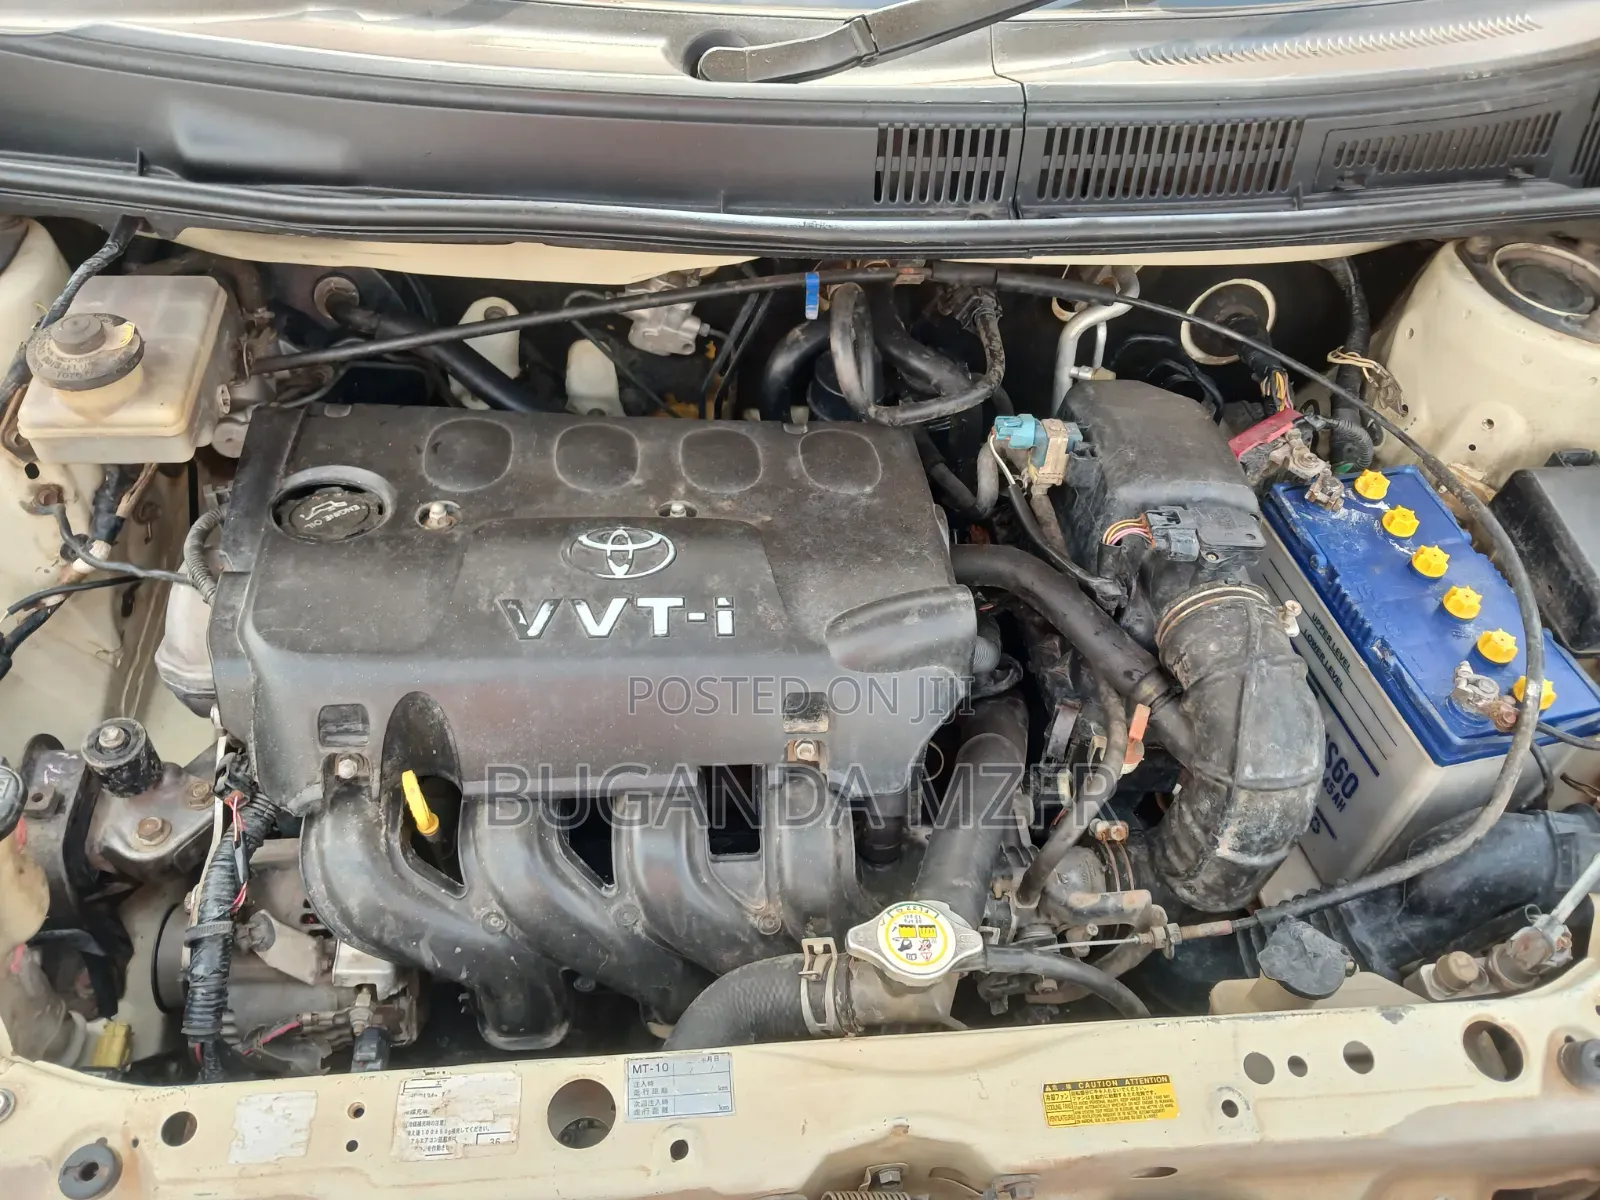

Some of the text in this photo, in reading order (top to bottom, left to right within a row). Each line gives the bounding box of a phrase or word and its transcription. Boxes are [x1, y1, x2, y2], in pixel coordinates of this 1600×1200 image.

[304, 519, 323, 529] OIL
[497, 596, 736, 640] VVT-i
[1304, 628, 1344, 693] LOWER LEVEL
[1311, 612, 1352, 673] UPPER LEVEL
[1325, 733, 1359, 800] S60
[632, 1062, 669, 1074] MT-10
[1078, 1079, 1118, 1089] CAUTION
[1124, 1076, 1169, 1086] ATTENTION
